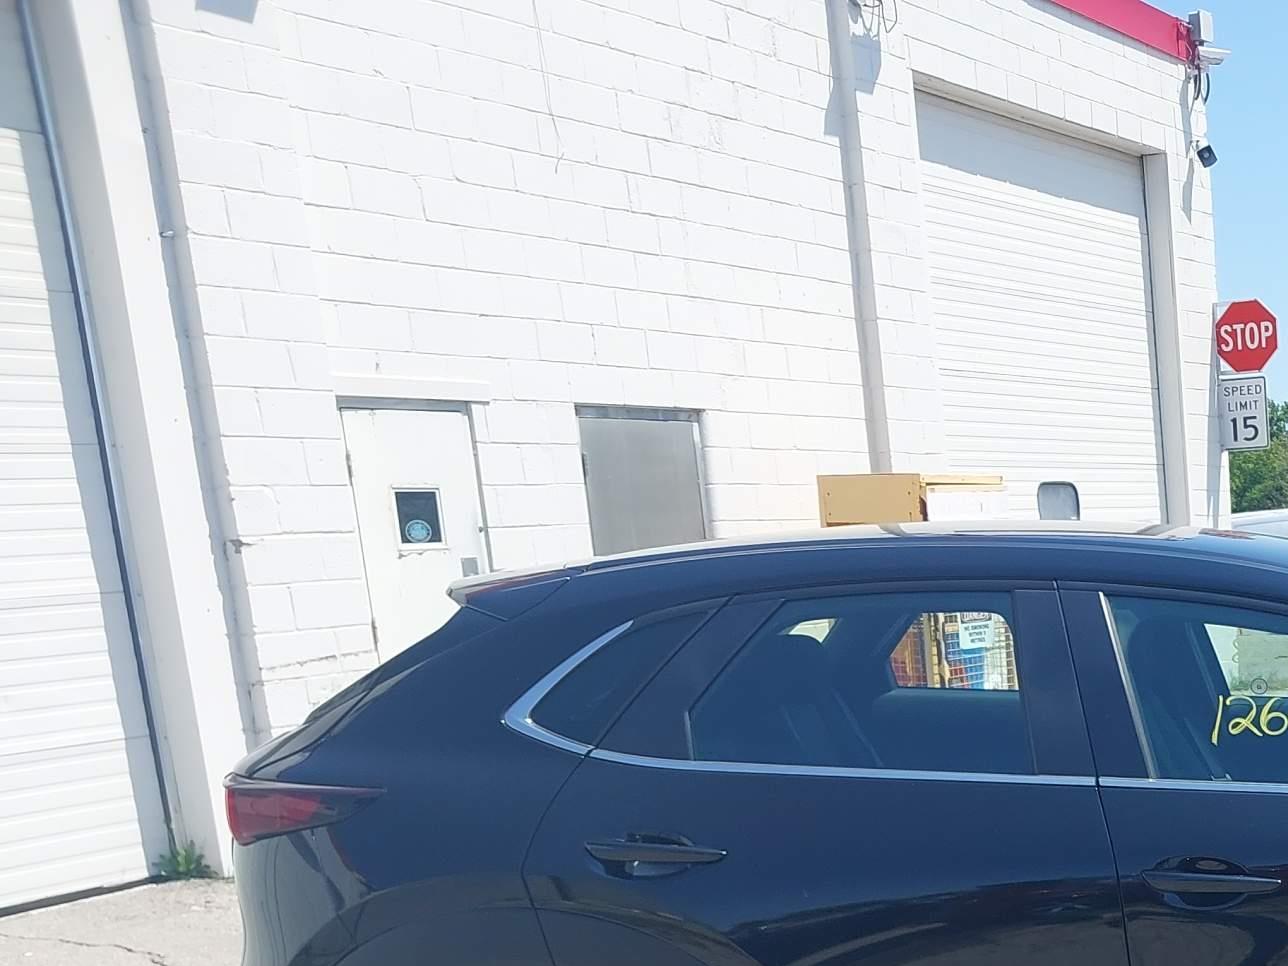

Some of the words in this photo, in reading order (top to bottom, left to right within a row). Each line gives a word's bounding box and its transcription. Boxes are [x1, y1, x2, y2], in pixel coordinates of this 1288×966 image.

[1220, 321, 1274, 352] STOP
[1223, 384, 1262, 397] SPEED
[1227, 400, 1259, 412] LIMIT
[1230, 416, 1259, 442] 15
